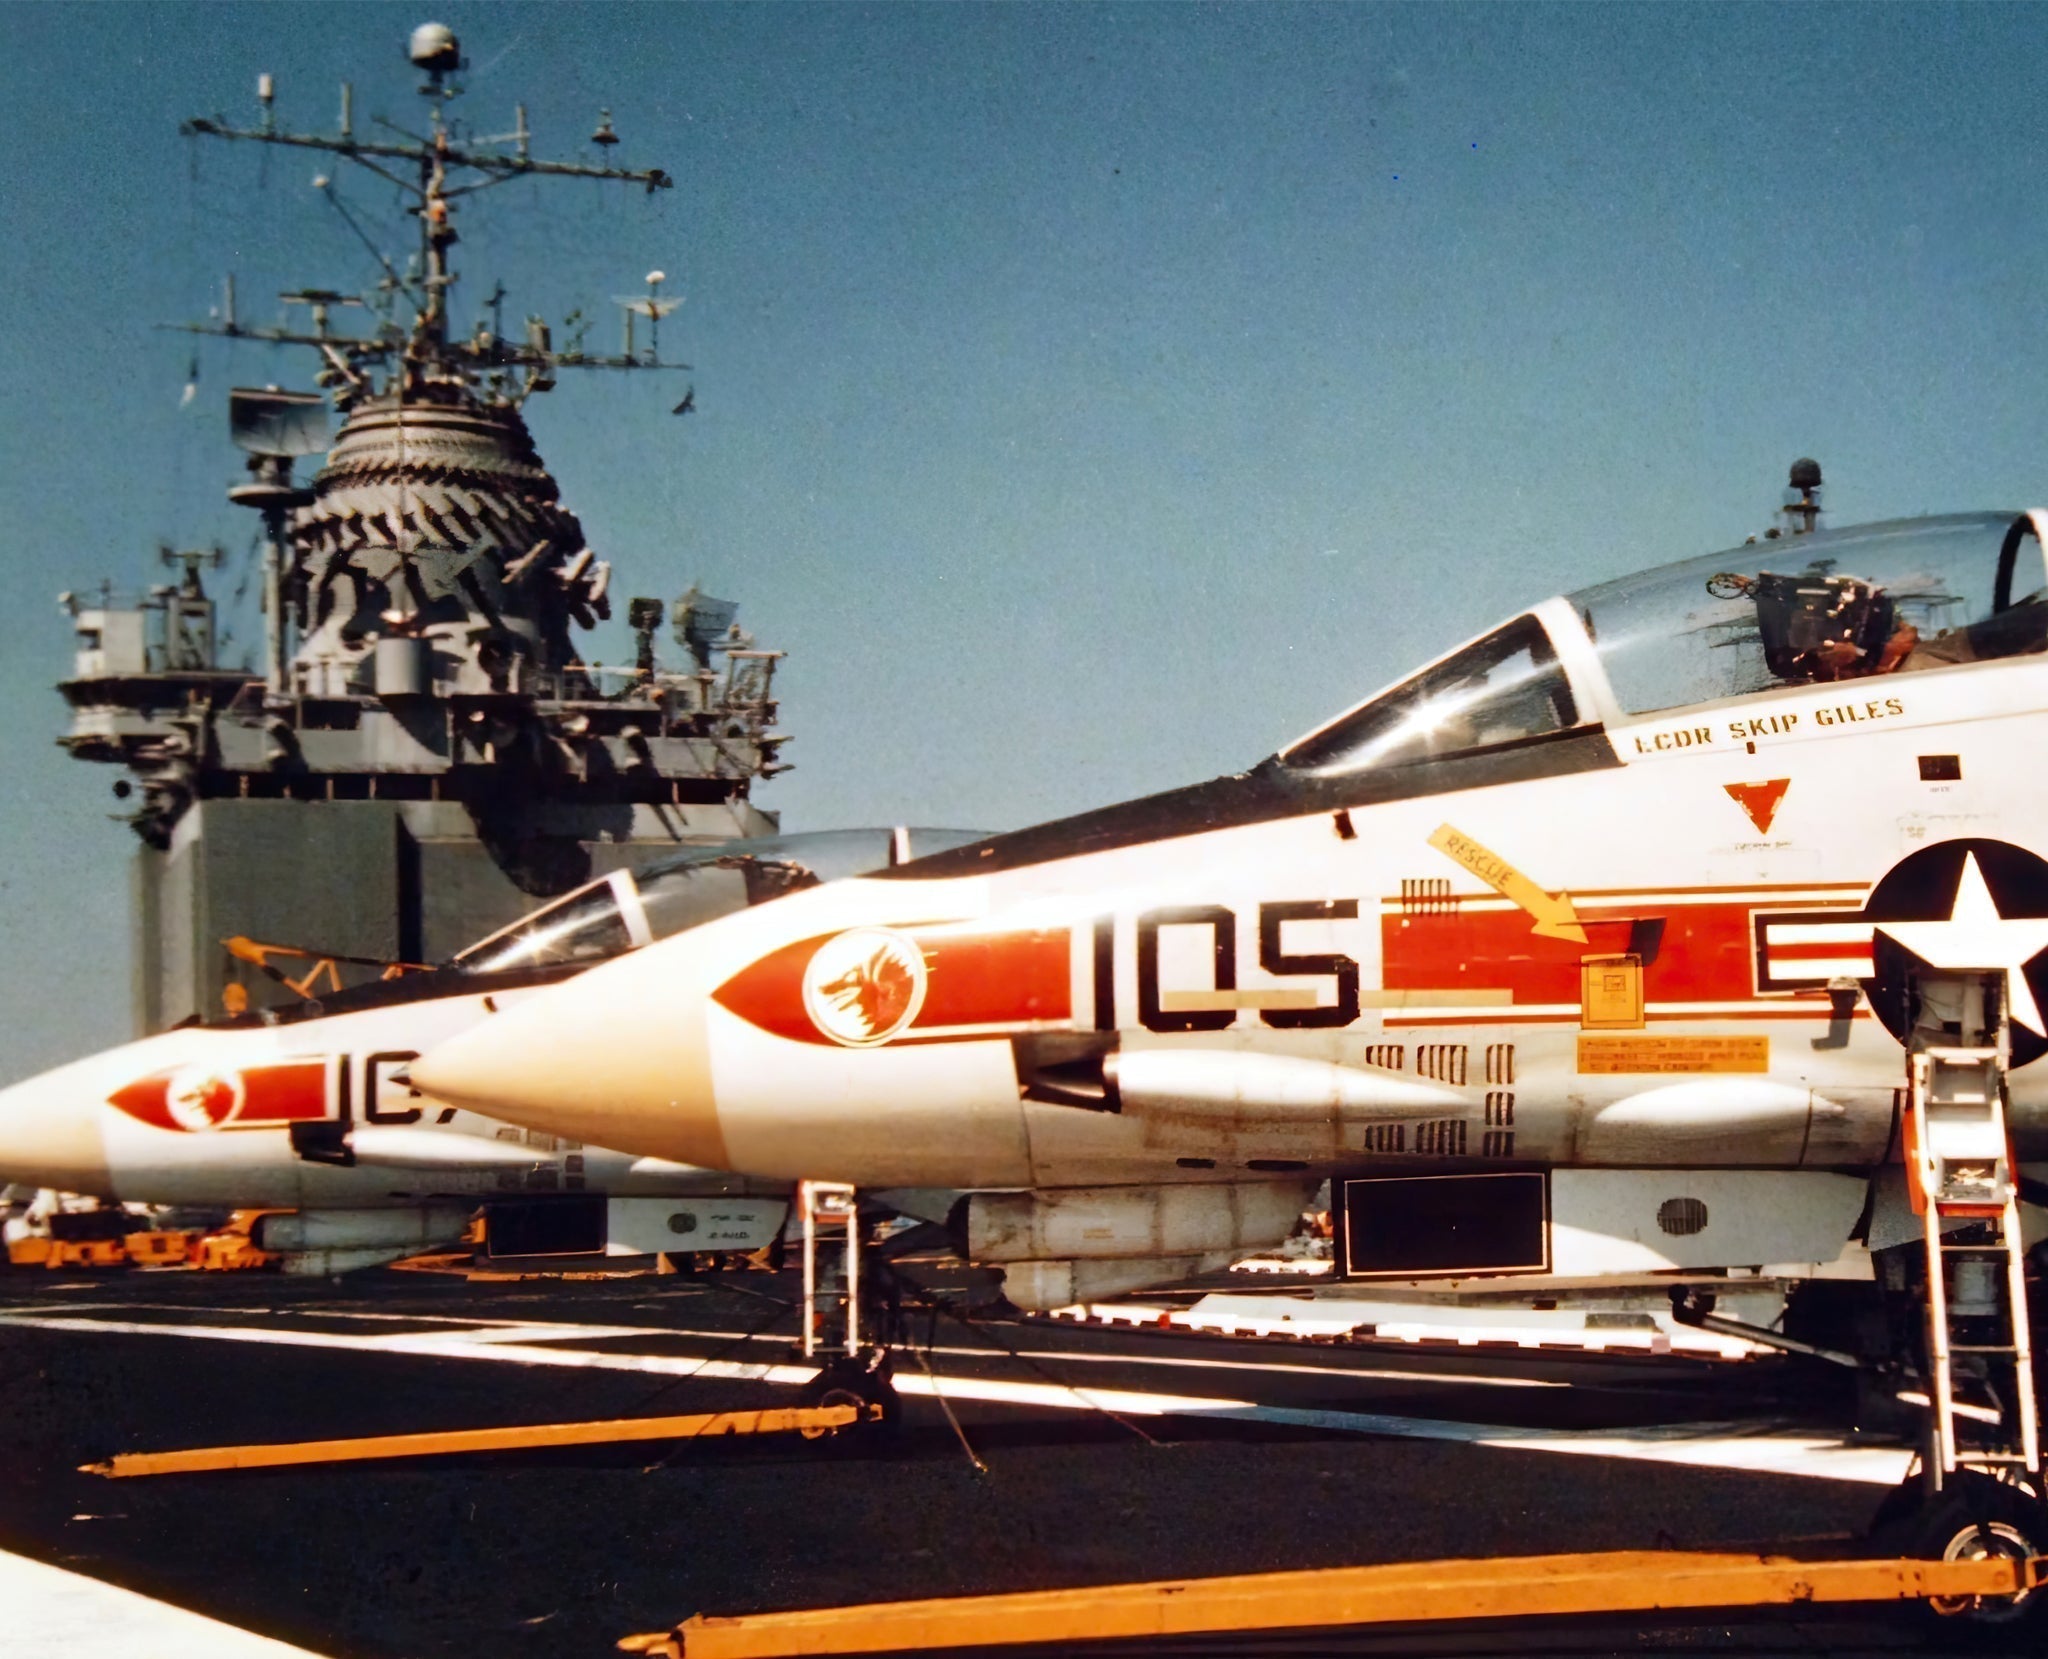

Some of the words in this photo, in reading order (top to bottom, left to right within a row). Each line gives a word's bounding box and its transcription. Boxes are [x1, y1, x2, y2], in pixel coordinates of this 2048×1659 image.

[1634, 727, 1713, 754] LCDR
[1728, 713, 1798, 740] SKIP
[1815, 698, 1904, 726] GILES
[1445, 834, 1513, 887] RESCUE
[1094, 898, 1360, 1034] 105
[339, 1050, 457, 1125] 10
